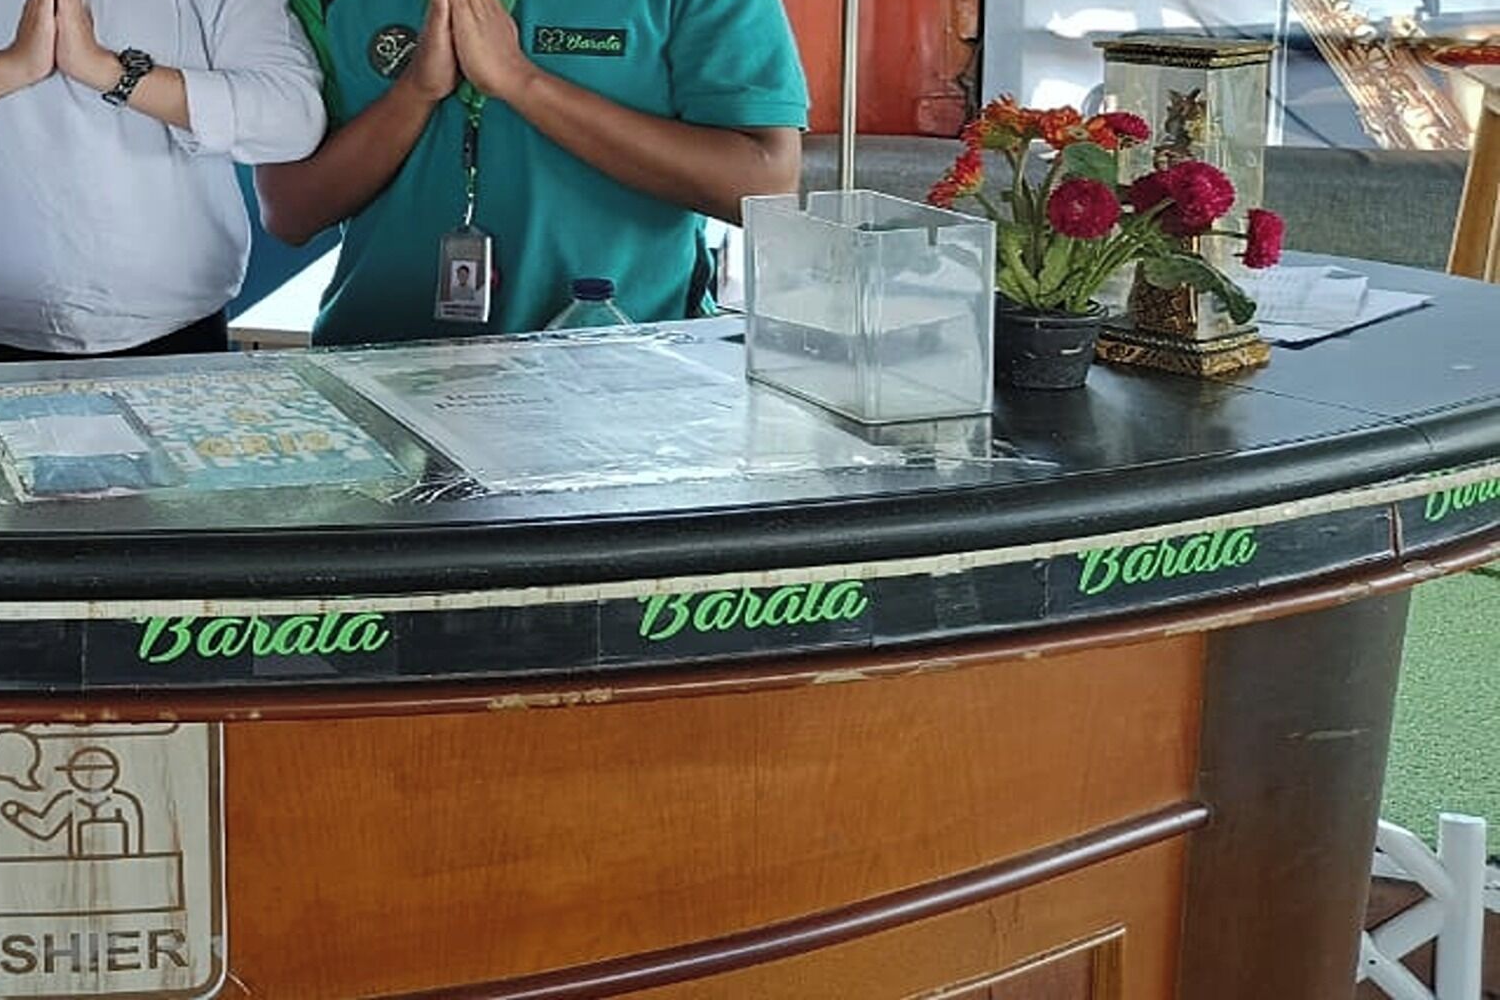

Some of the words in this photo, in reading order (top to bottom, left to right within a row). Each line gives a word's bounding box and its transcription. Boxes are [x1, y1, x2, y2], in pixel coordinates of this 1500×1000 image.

[1077, 527, 1258, 594] Barata
[135, 609, 390, 662] Barata
[637, 578, 869, 640] Barata
